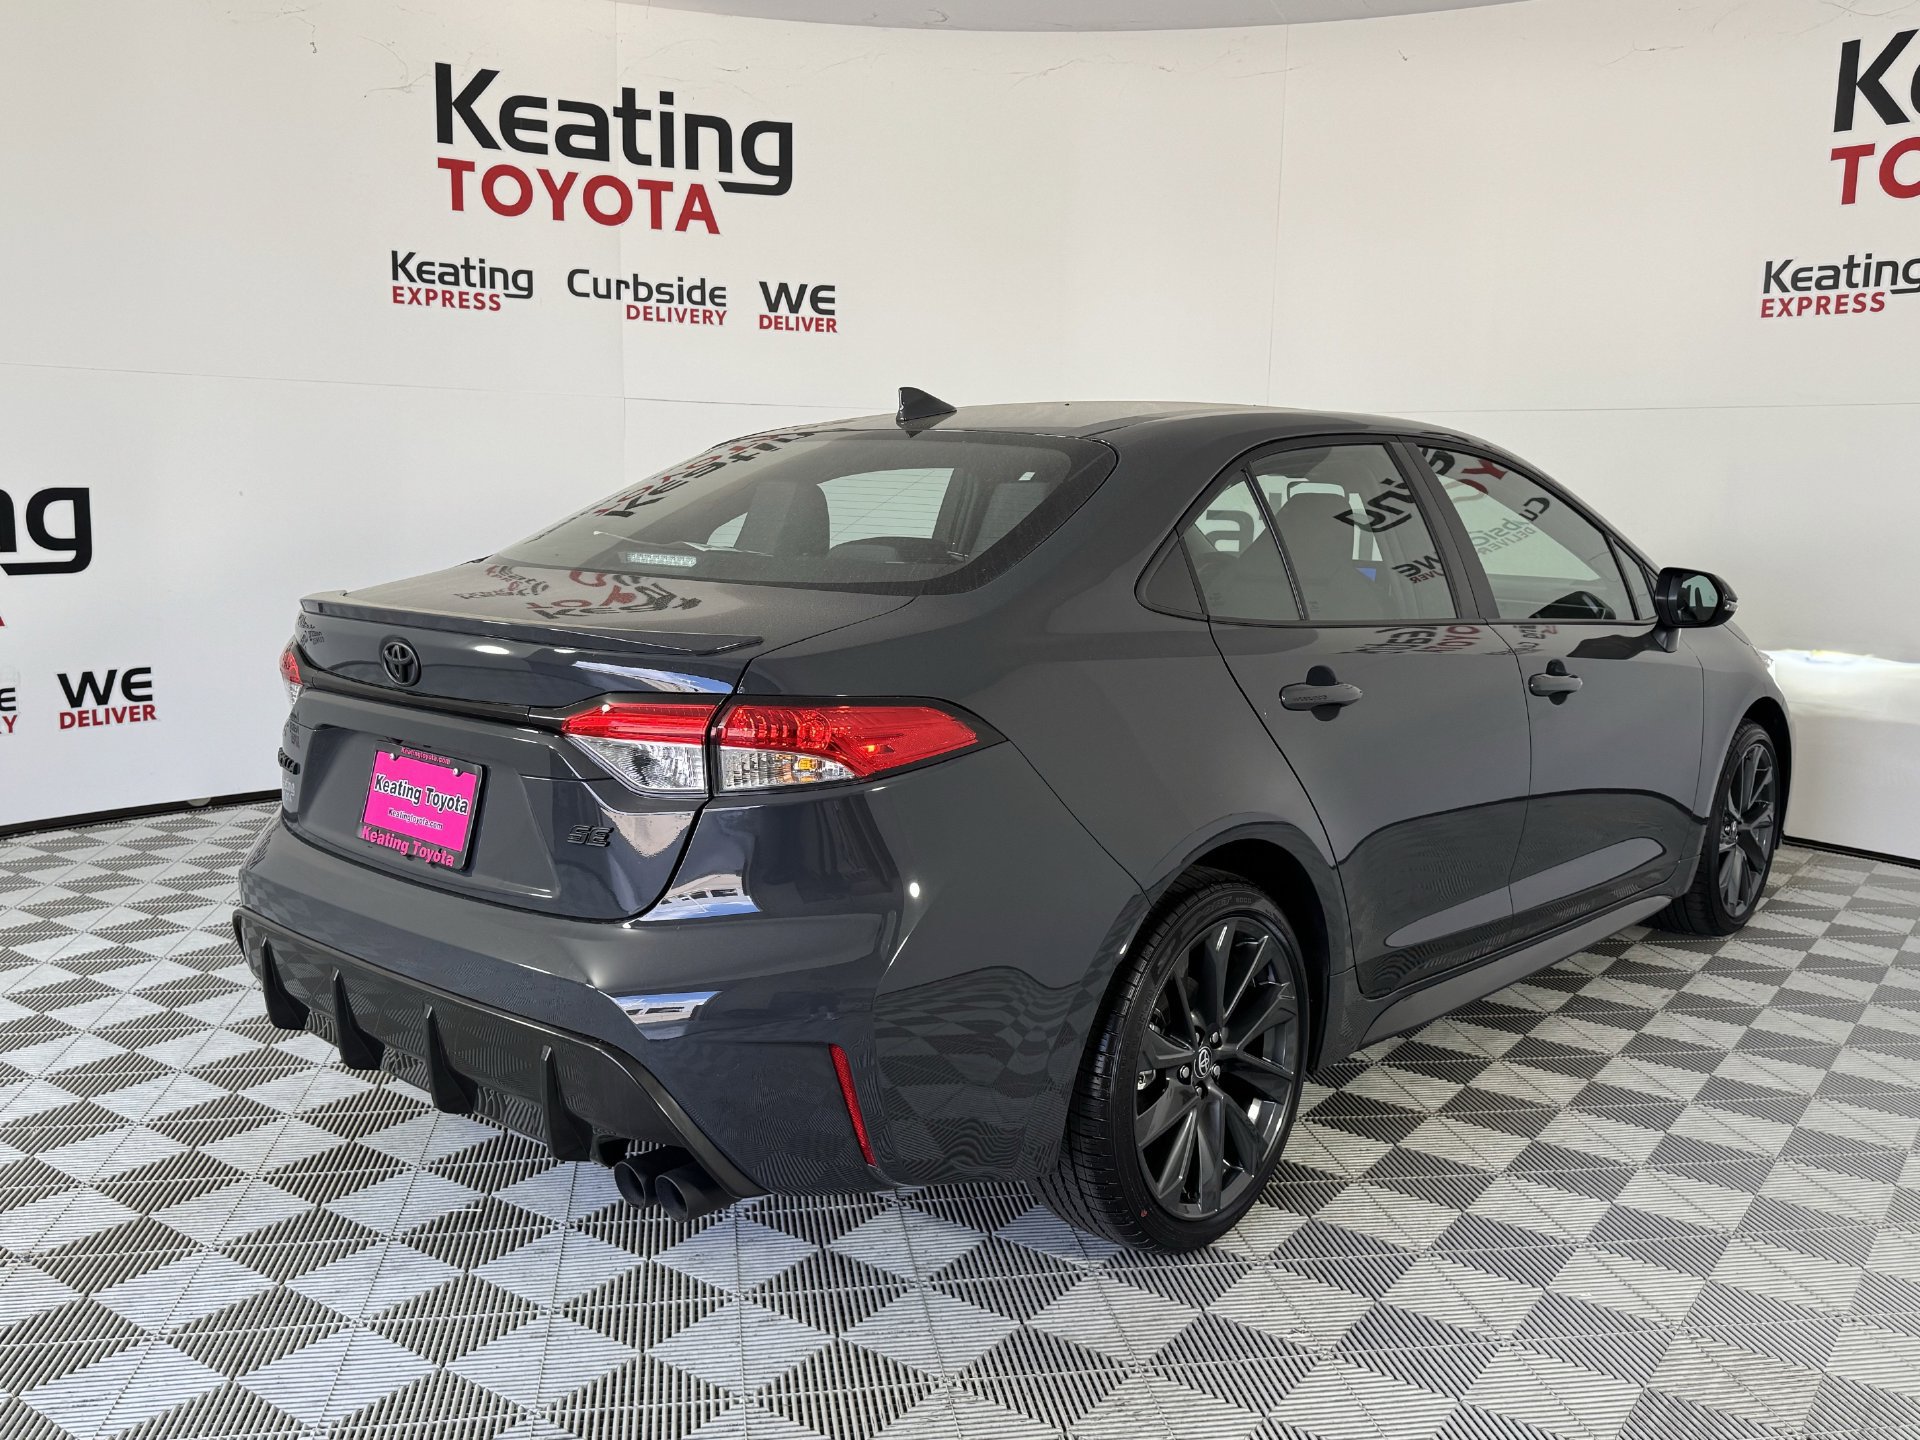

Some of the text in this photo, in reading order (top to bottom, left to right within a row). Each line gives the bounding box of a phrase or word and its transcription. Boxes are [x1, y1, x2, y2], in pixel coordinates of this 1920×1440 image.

[1834, 29, 1920, 132] K
[435, 62, 792, 196] Keating
[438, 158, 720, 235] TOYOTA
[391, 250, 533, 299] Keating
[567, 269, 727, 307] Curbside
[1763, 253, 1920, 294] Keating
[392, 286, 501, 311] EXPRESS
[626, 304, 727, 326] DELIVERY
[1761, 292, 1885, 318] EXPRESS
[759, 314, 837, 333] DELIVER
[59, 704, 157, 729] DELIVER
[374, 773, 468, 814] Keating Toyota
[361, 826, 455, 866] Keating Toyota
[567, 824, 612, 848] SE
